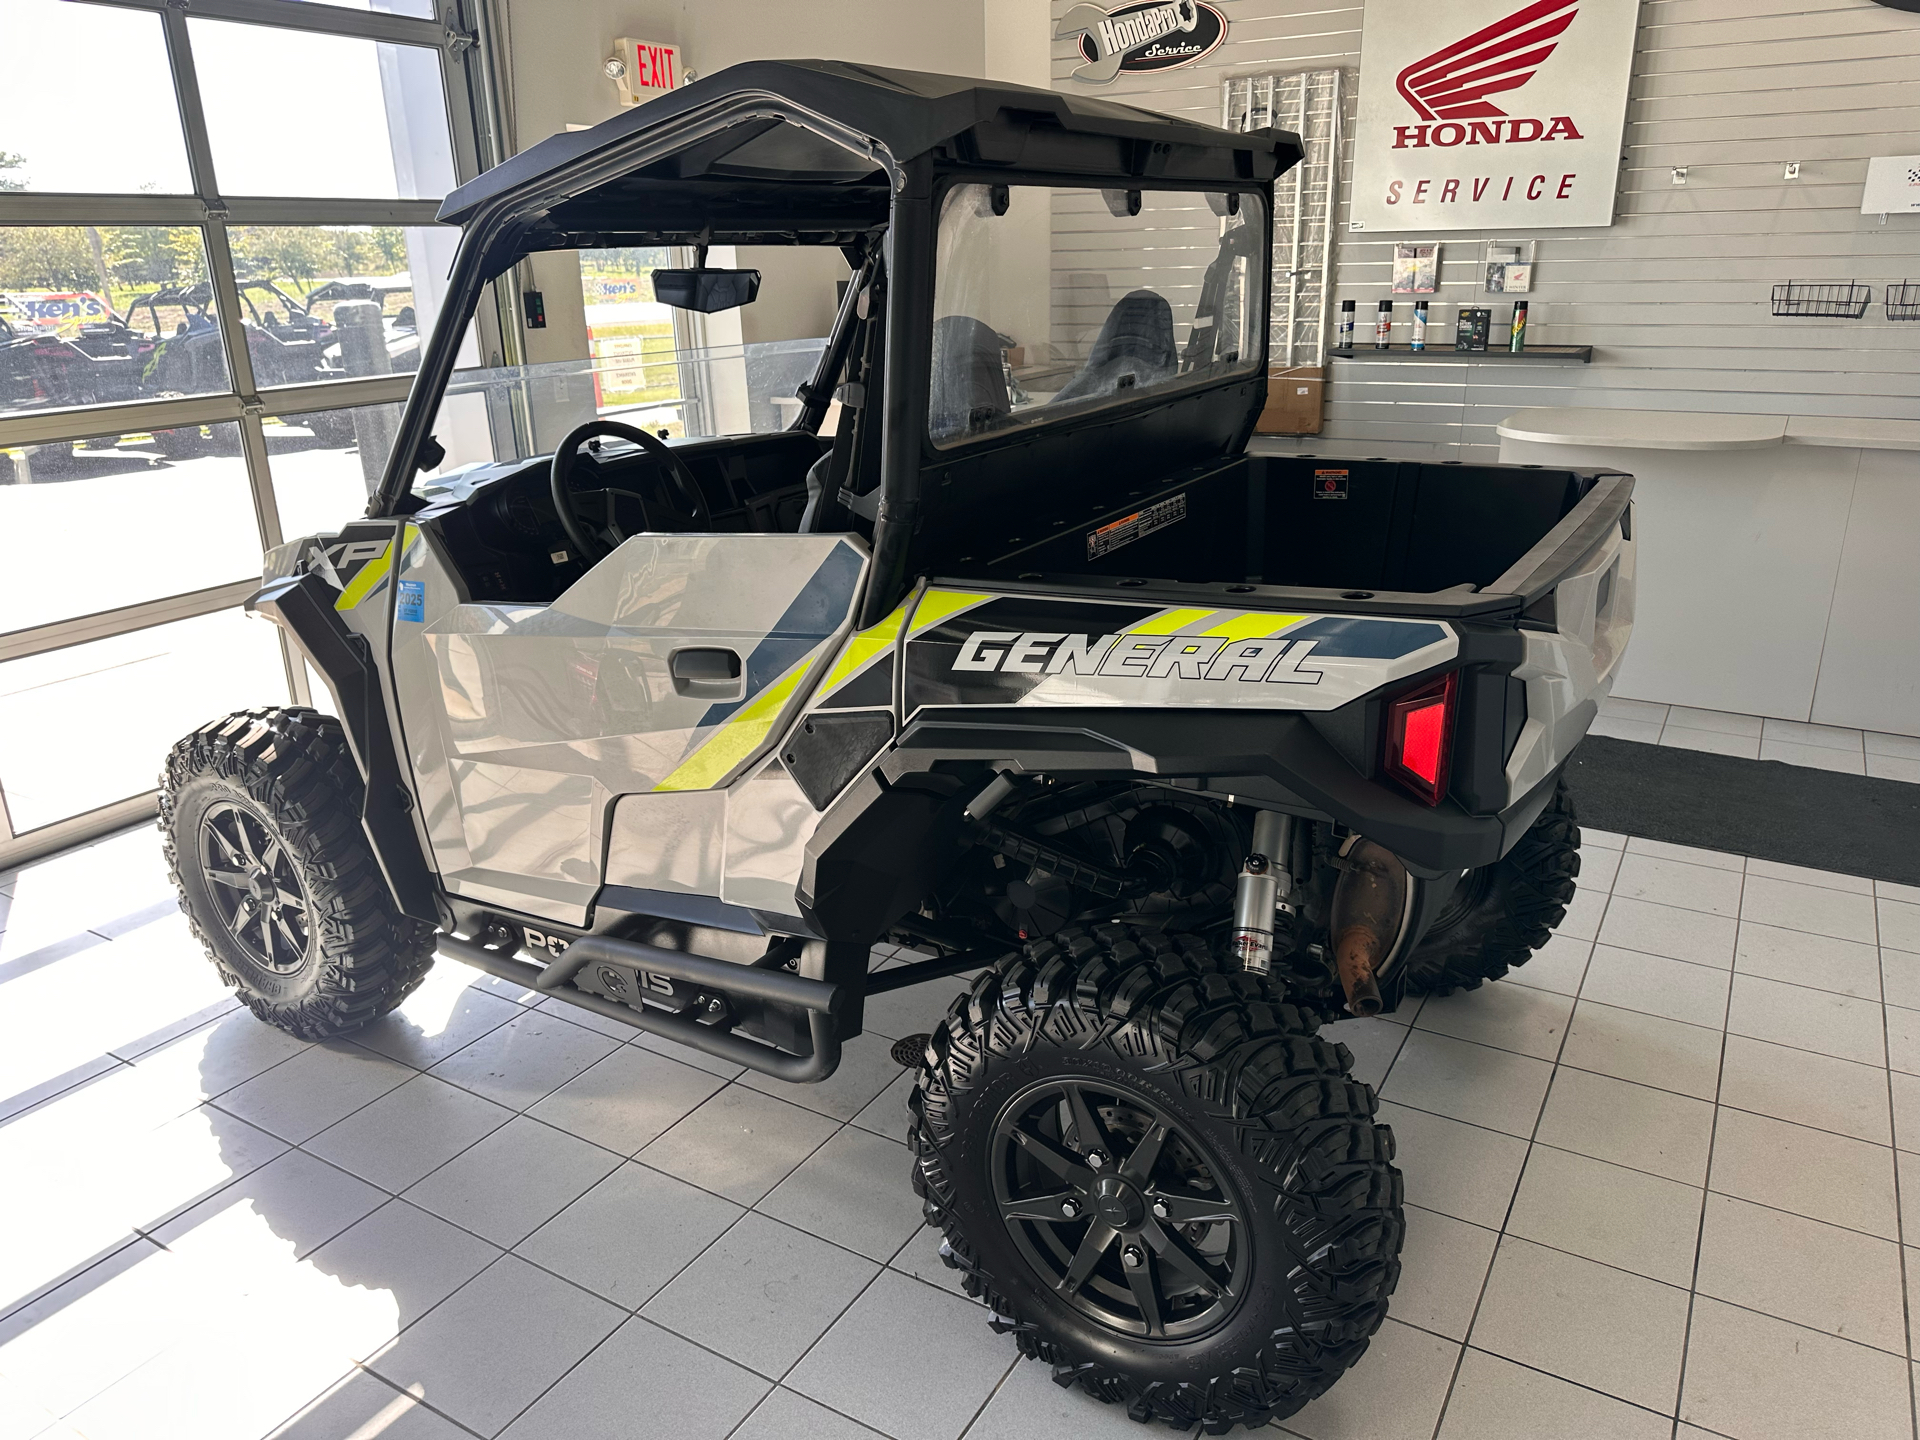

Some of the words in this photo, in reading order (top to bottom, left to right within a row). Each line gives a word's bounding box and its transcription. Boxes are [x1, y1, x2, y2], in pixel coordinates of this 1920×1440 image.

[1097, 7, 1178, 56] HondaPro
[1145, 41, 1203, 57] Service
[636, 44, 674, 90] EXIT
[1391, 116, 1584, 149] HONDA
[1386, 173, 1577, 205] SERVICE
[307, 539, 392, 571] XP
[399, 592, 423, 607] 2025
[950, 631, 1324, 685] GENERAL
[521, 926, 674, 997] POIS
